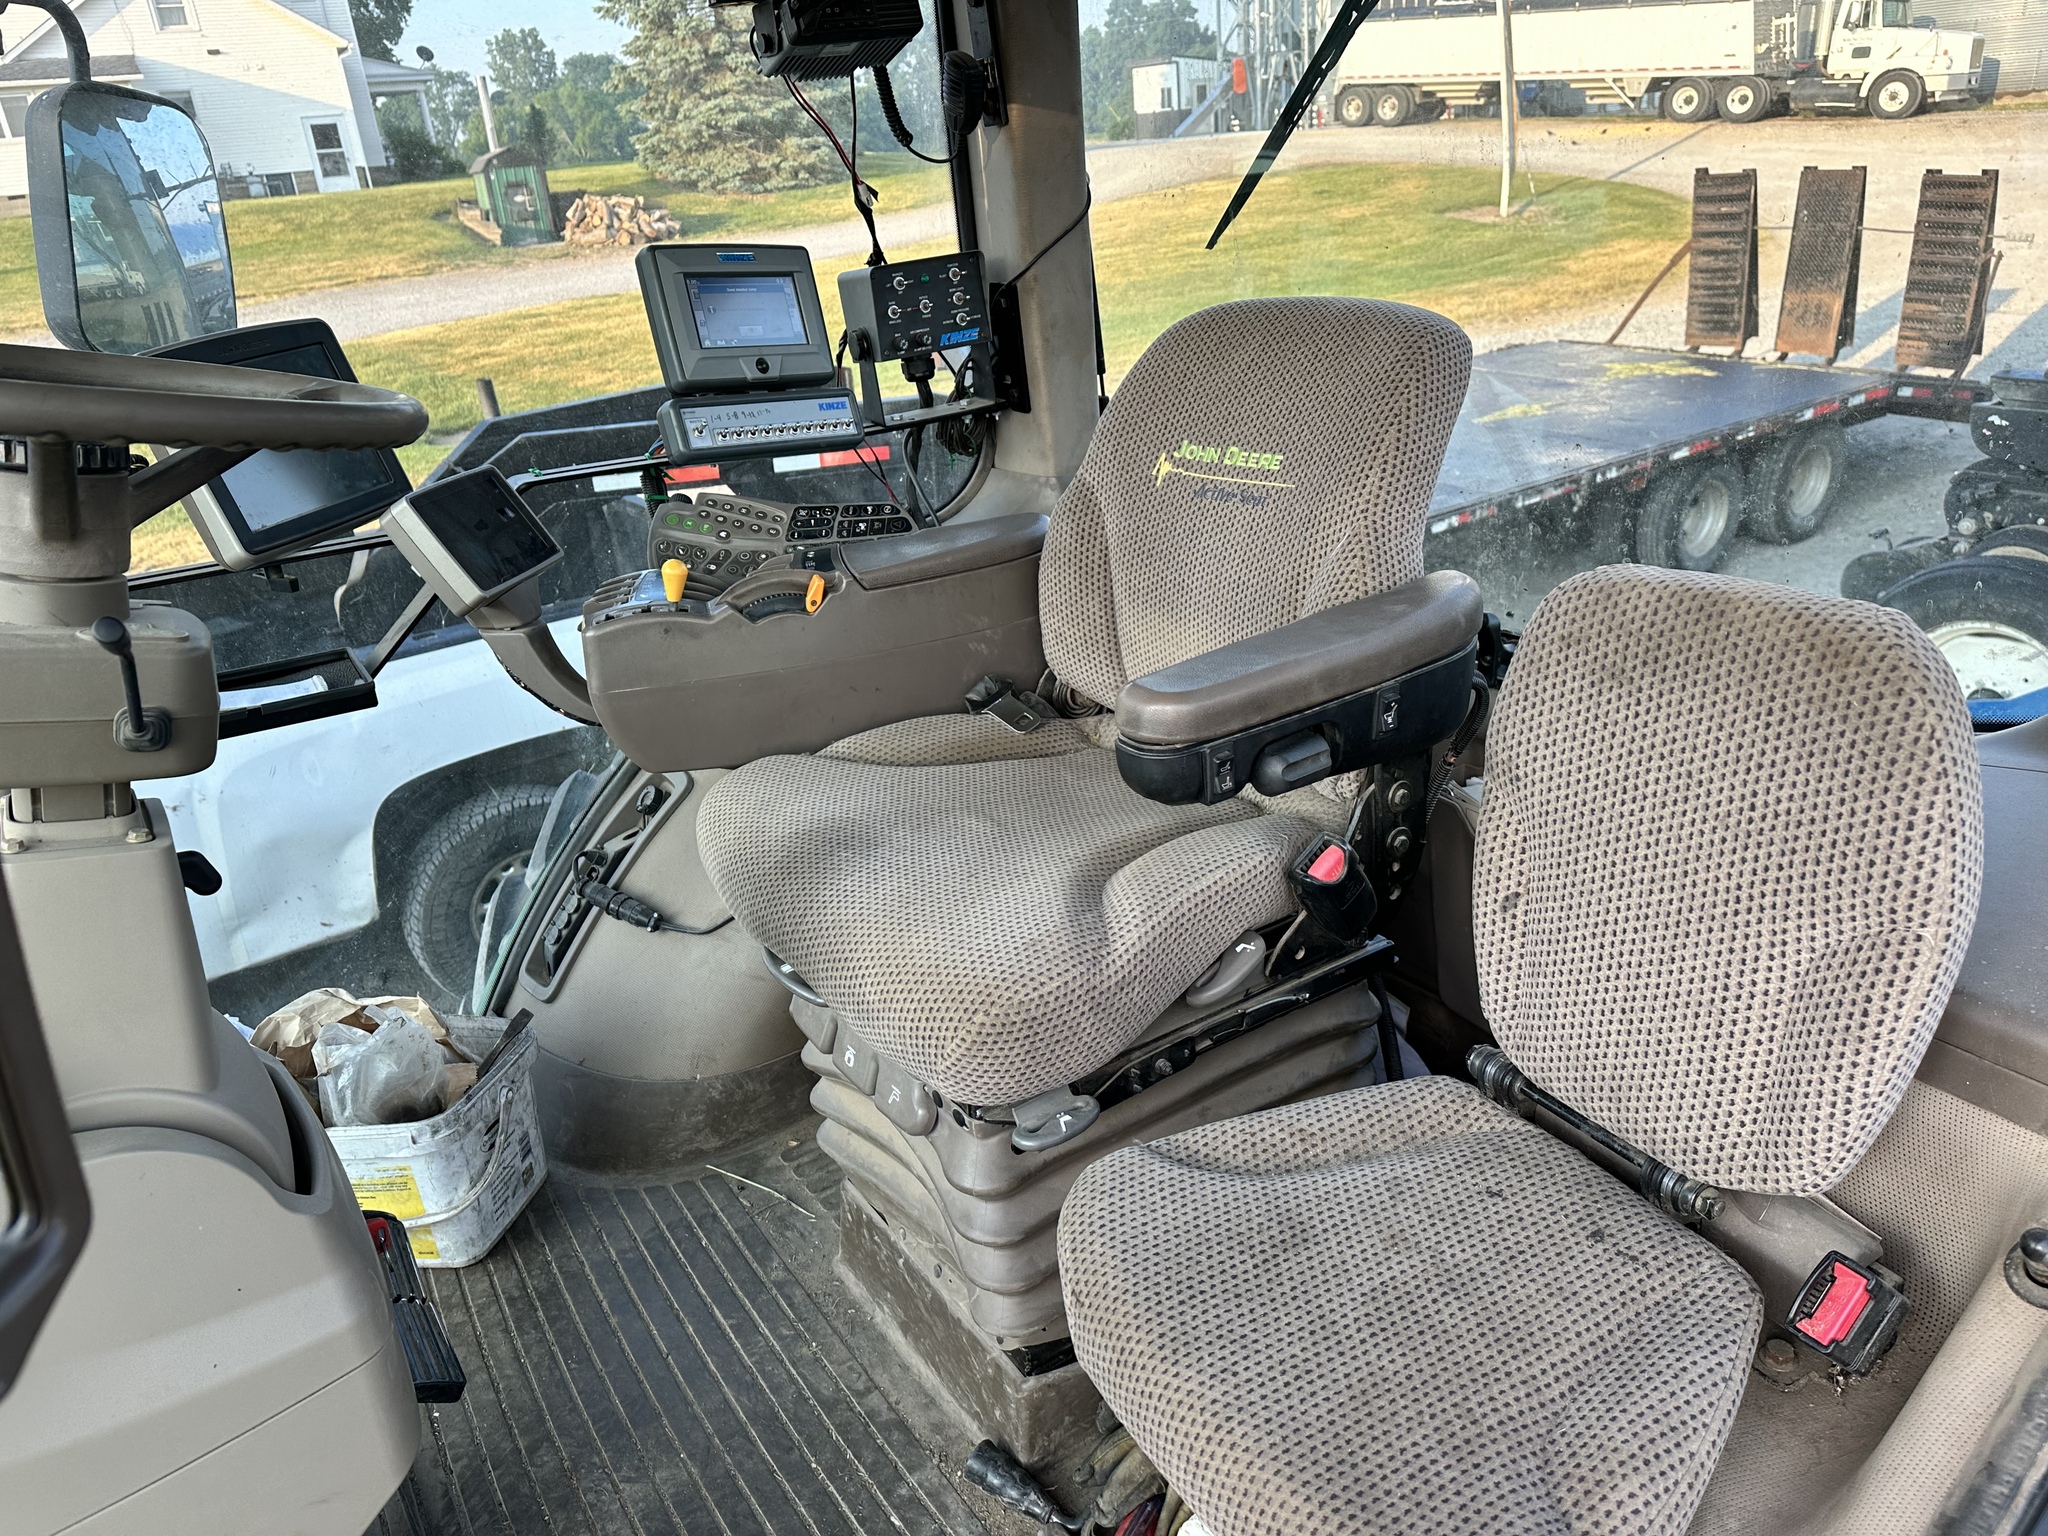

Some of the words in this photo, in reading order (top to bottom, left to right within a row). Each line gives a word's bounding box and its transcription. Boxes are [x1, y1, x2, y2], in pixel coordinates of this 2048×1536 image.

[940, 327, 980, 346] KINZE
[218, 344, 242, 357] JOHN
[818, 401, 848, 412] KINZE
[726, 411, 739, 421] 5-8
[1173, 440, 1221, 463] JOHN
[1223, 446, 1284, 470] DEERE
[1194, 483, 1237, 504] Active
